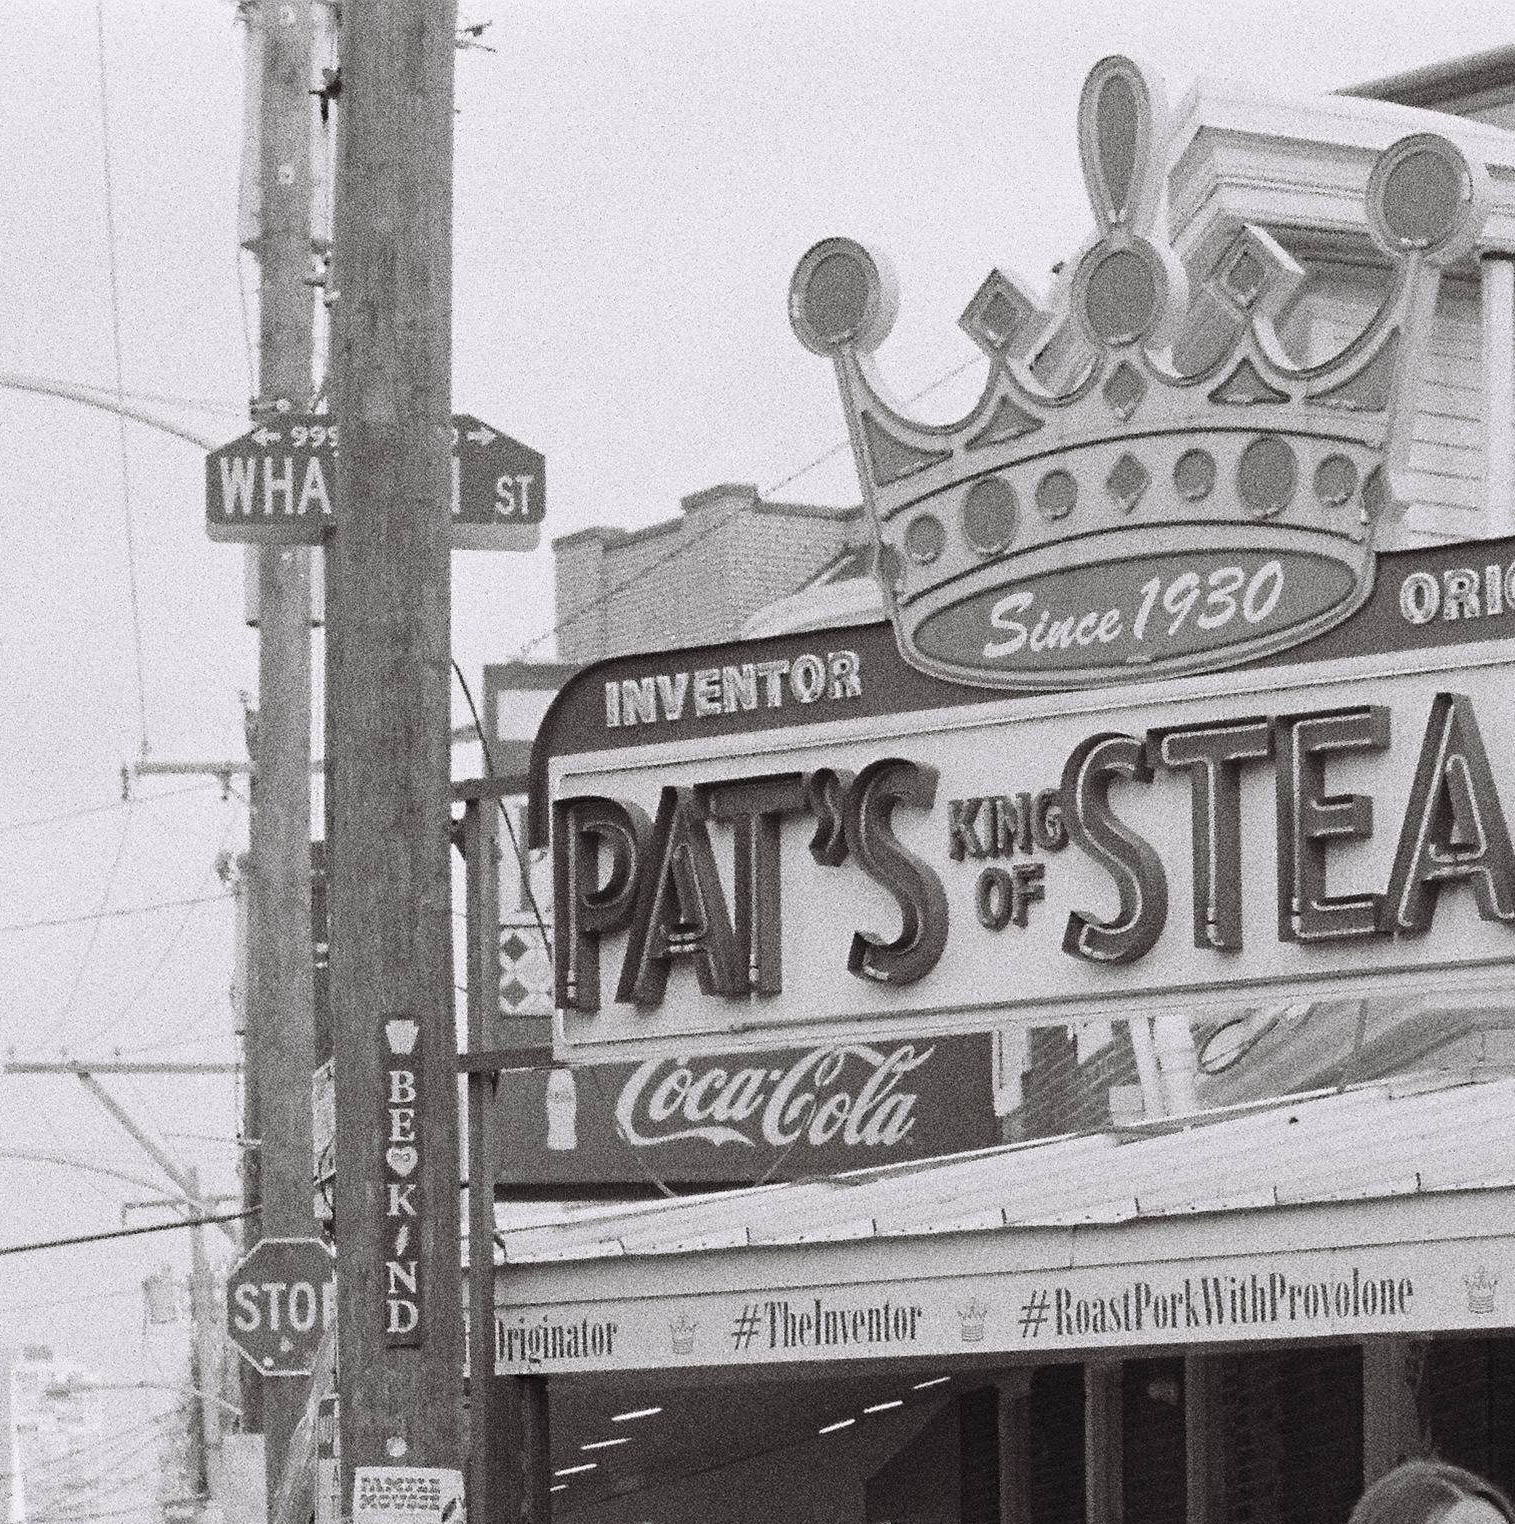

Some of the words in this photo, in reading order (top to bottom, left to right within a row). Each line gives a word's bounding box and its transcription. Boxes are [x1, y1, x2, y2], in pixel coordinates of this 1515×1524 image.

[494, 474, 534, 516] ST
[983, 591, 1123, 660] Since
[1127, 562, 1284, 640] 1930
[604, 650, 863, 729] INVENTOR
[553, 757, 950, 1013] PAT'S
[949, 788, 1070, 861] KING
[975, 862, 1046, 931] OF
[387, 1069, 417, 1143] BE
[615, 1044, 934, 1147] Coca-Cola
[731, 1298, 924, 1352] #TheInventor
[1018, 1267, 1415, 1339] #RoastPorkWithProvolone
